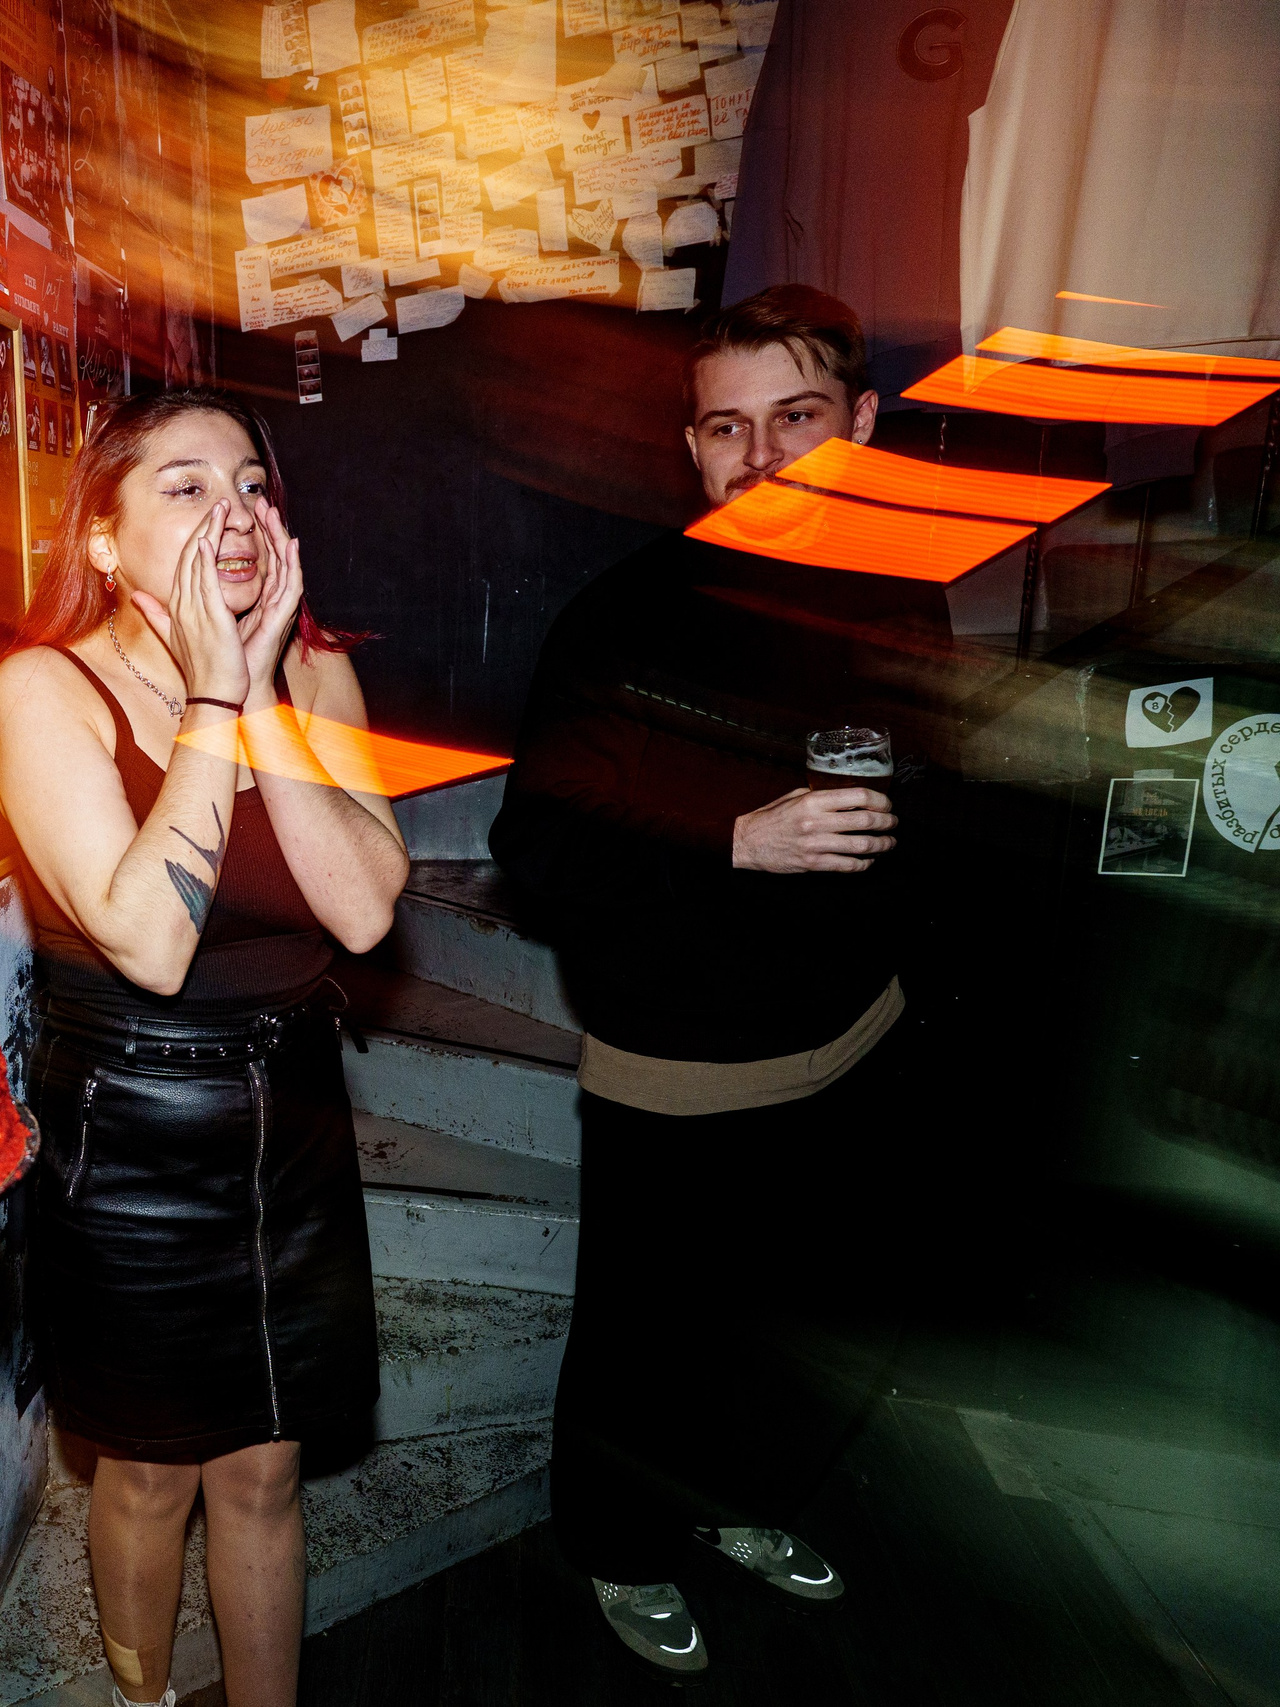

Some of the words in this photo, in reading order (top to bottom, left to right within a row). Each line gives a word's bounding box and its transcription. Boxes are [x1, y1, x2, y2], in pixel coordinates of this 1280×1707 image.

[24, 273, 37, 290] THE
[14, 292, 40, 316] SUMMER
[53, 321, 69, 338] PARTY
[1220, 721, 1280, 754] серде
[1212, 758, 1261, 844] разбитых
